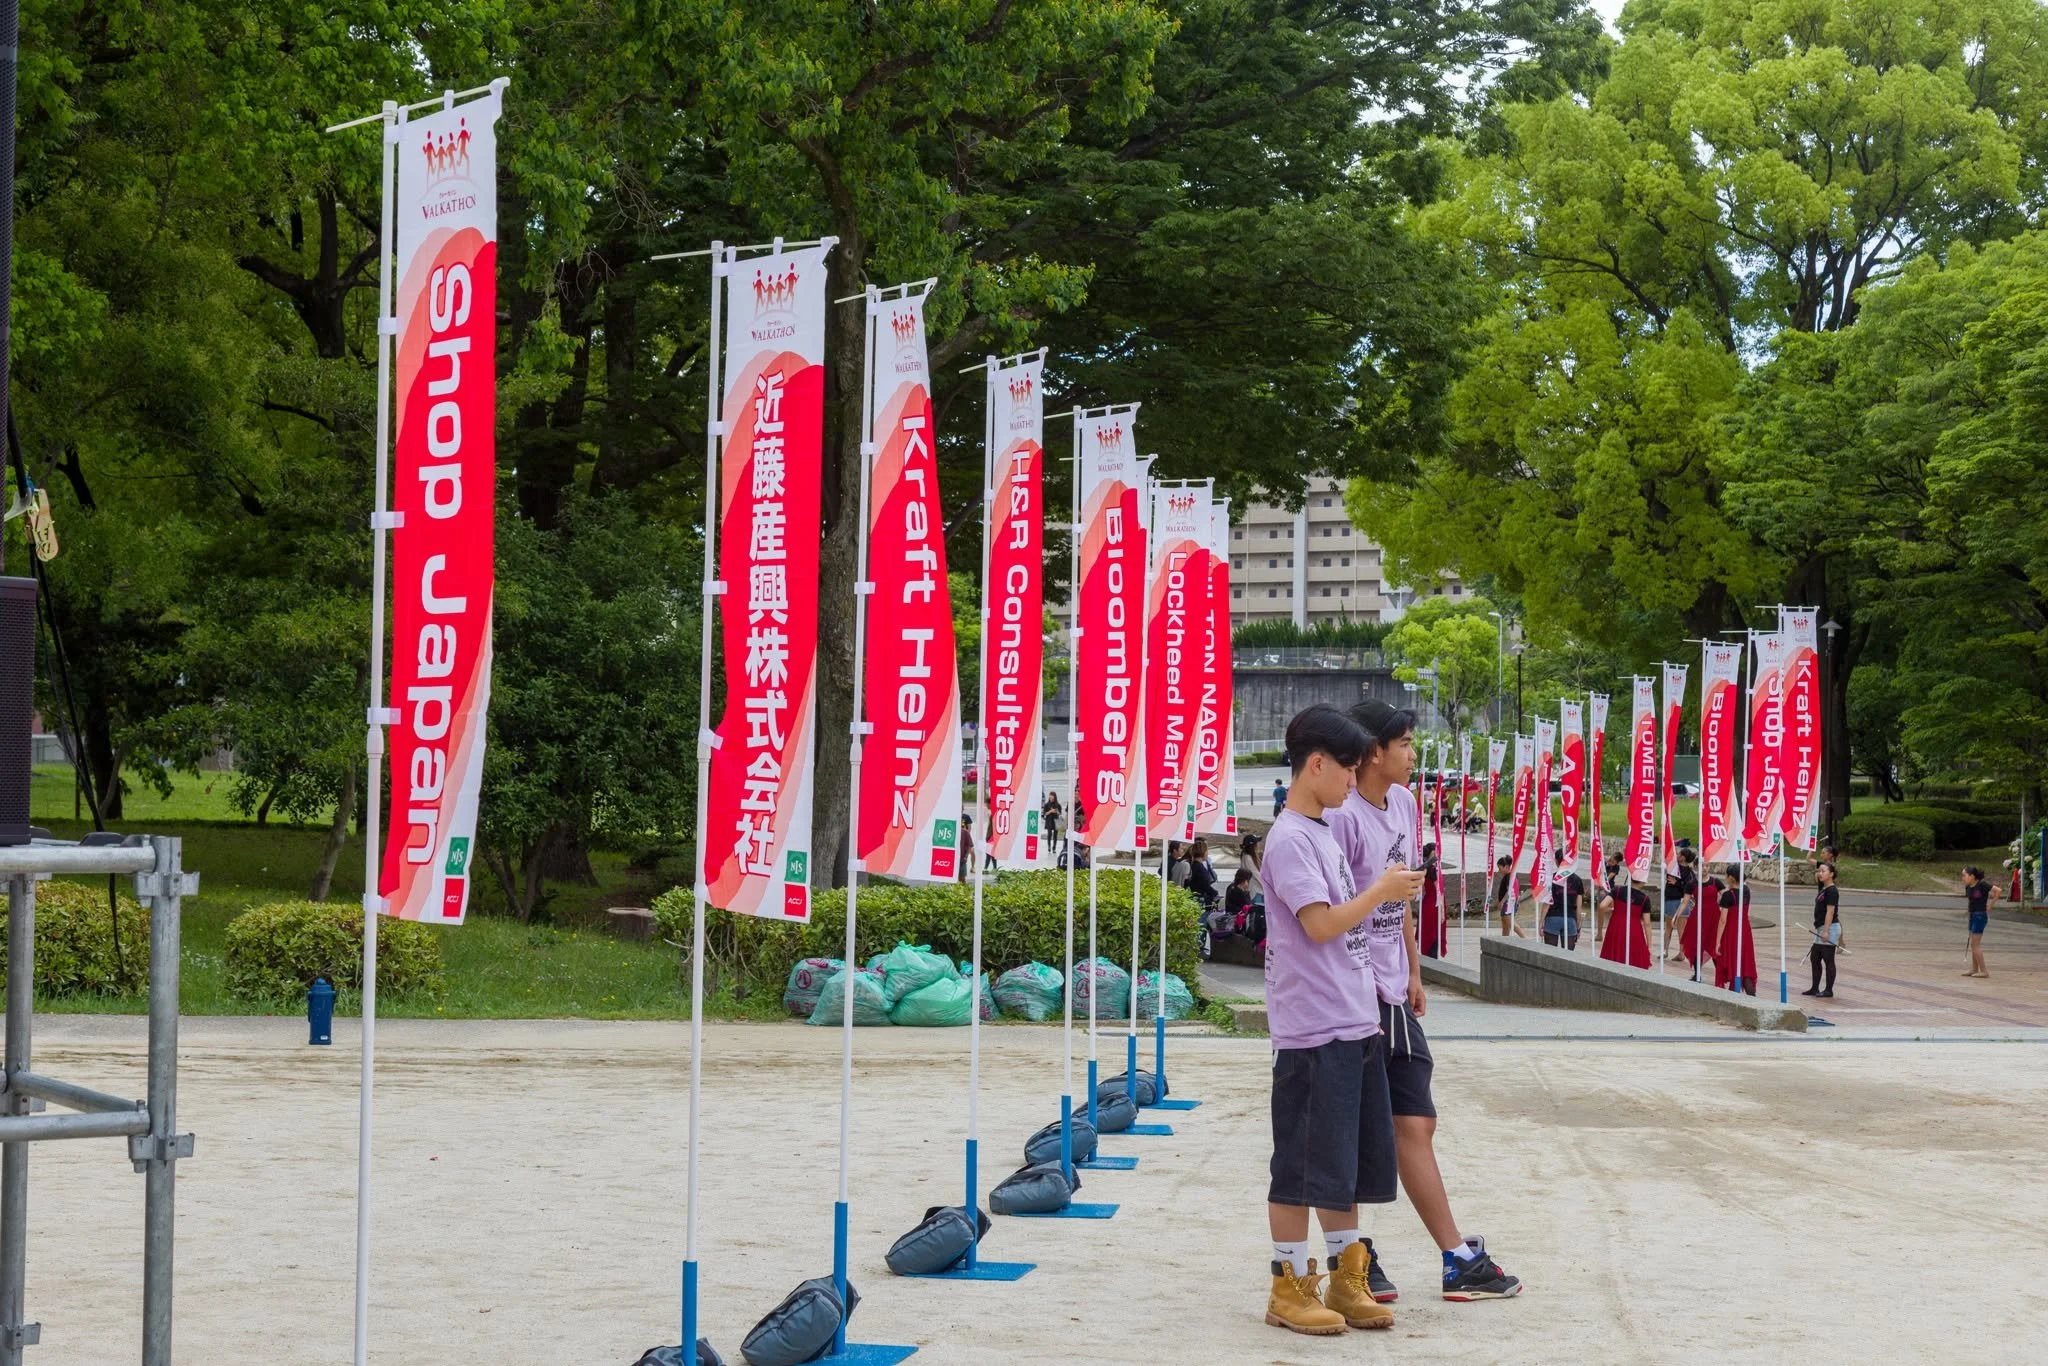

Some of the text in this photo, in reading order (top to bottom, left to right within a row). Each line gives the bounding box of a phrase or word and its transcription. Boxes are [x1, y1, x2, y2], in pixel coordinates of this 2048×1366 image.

[406, 264, 473, 866] Shop Japan
[734, 369, 789, 877] 近藤産興株式会社
[892, 416, 938, 829] Kraft Heinz
[1166, 551, 1188, 704] Lockheed
[995, 451, 1031, 835] H&R Consultants
[1097, 507, 1131, 807] Bloomberg
[1796, 659, 1812, 737] Kraft
[1157, 715, 1184, 816] Martin
[1196, 683, 1219, 816] NAGOYA
[1641, 720, 1656, 785] TOMEI
[1707, 692, 1729, 841] Bloomberg
[1754, 756, 1780, 840] Japan
[1792, 746, 1812, 829] Heinz
[1634, 793, 1655, 871] HOMES
